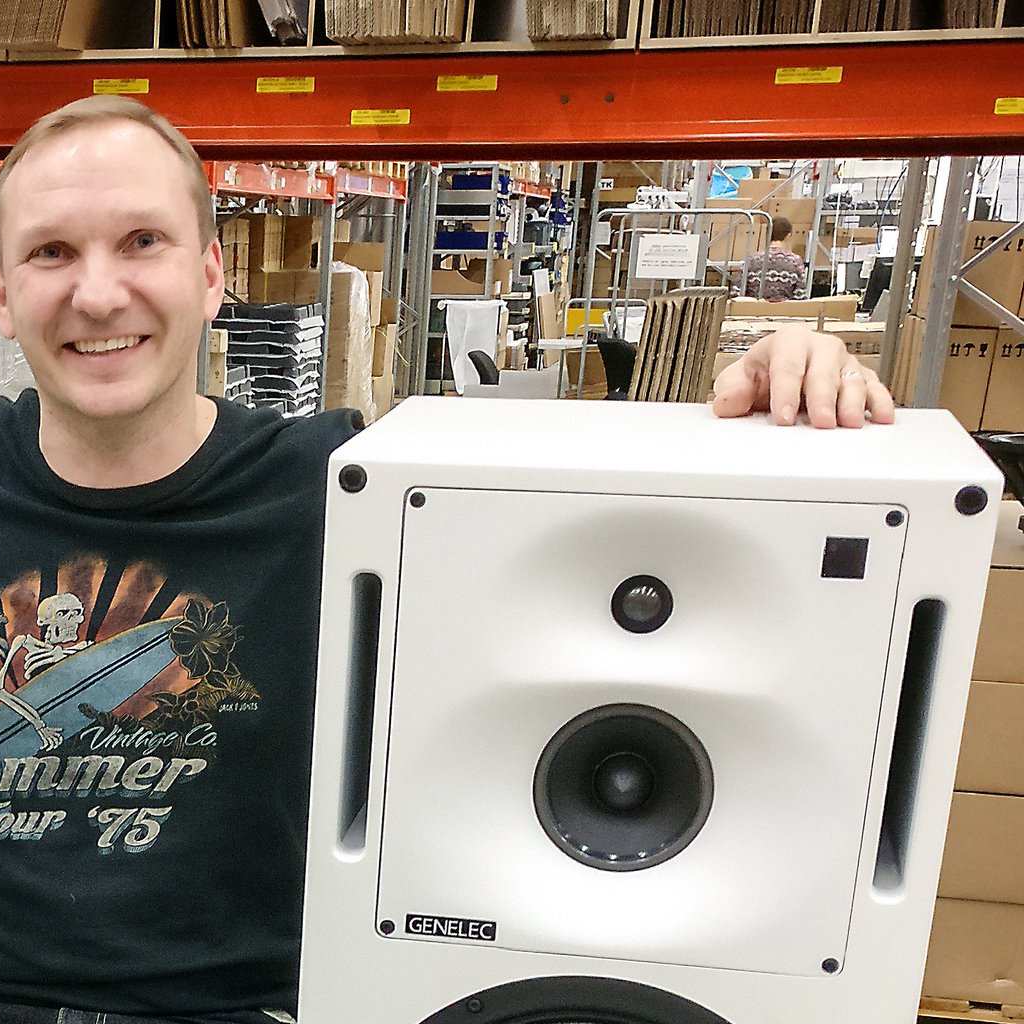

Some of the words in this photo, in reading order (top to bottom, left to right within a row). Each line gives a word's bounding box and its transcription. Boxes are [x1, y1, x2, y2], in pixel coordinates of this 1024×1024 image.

[80, 724, 178, 756] Vintage
[184, 722, 218, 747] Co.
[409, 917, 493, 939] GENELEC
